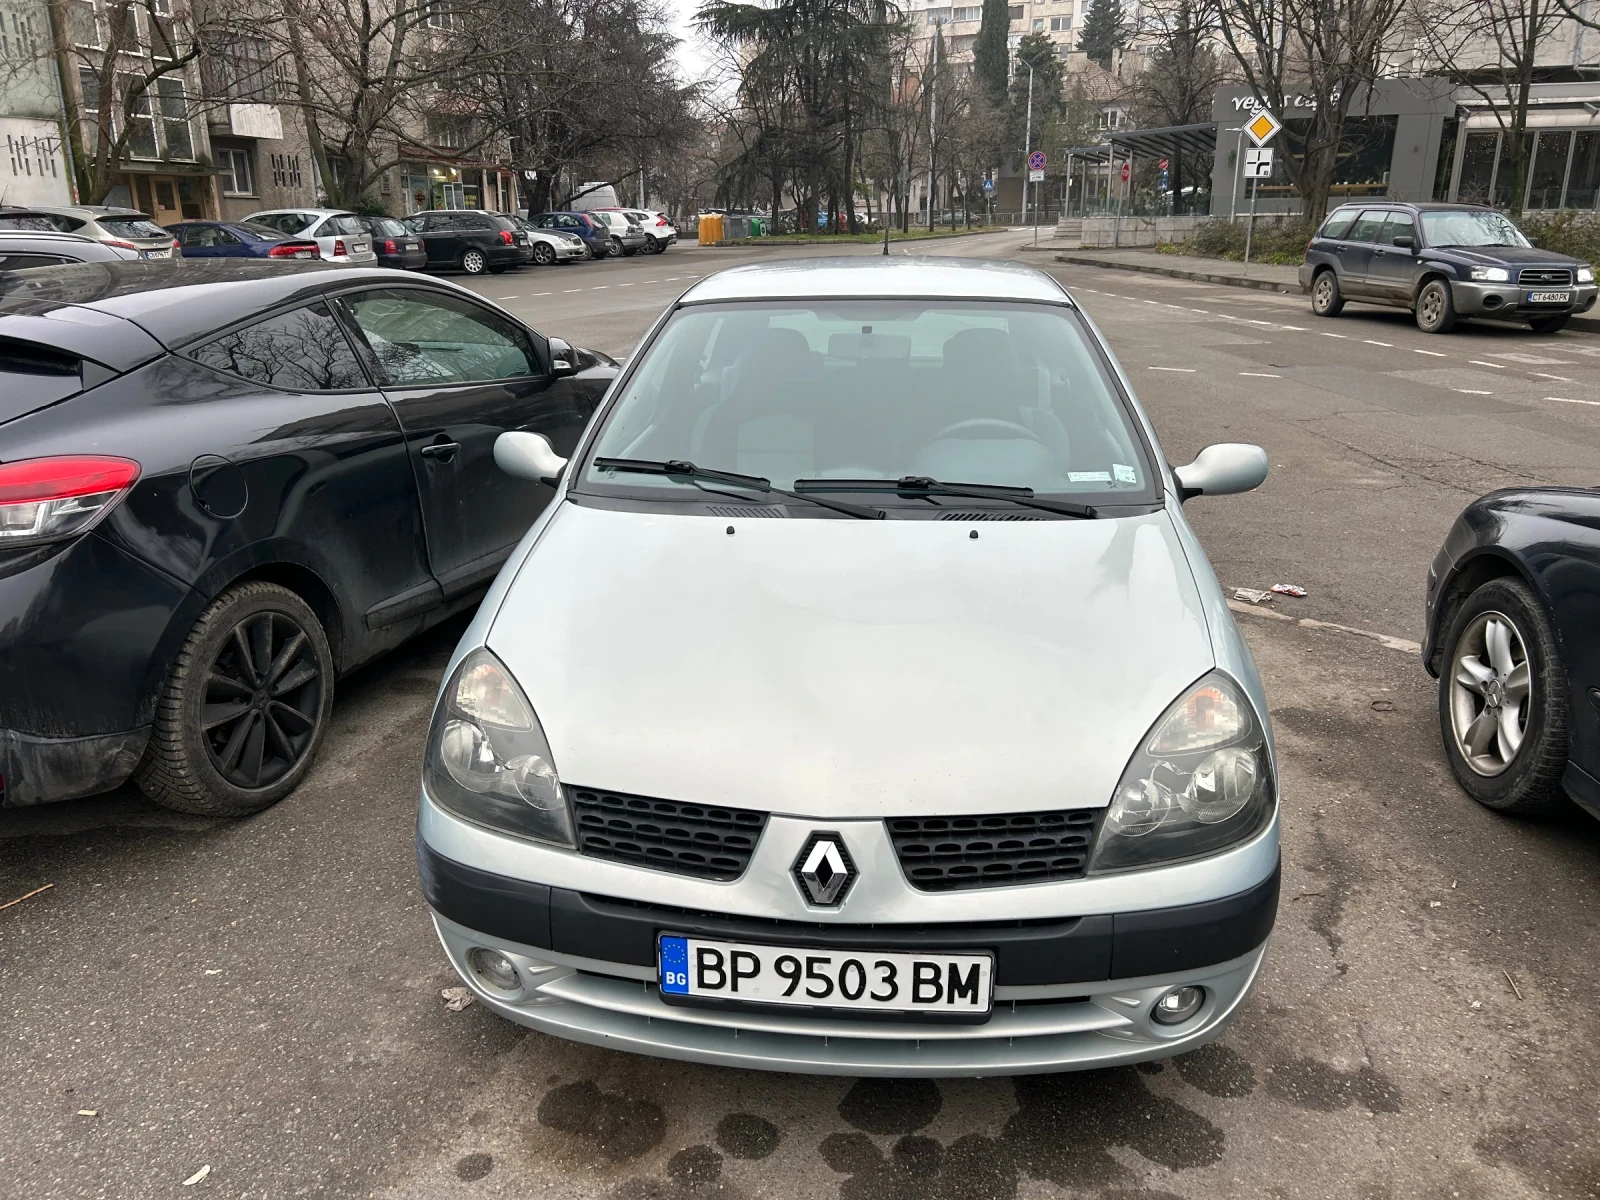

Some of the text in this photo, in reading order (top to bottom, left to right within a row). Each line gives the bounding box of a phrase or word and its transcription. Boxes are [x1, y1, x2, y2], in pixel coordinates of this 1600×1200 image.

[1533, 293, 1542, 301] CT
[1559, 293, 1568, 301] PK
[666, 971, 686, 986] BG
[696, 947, 981, 1005] BP 9503 BM
